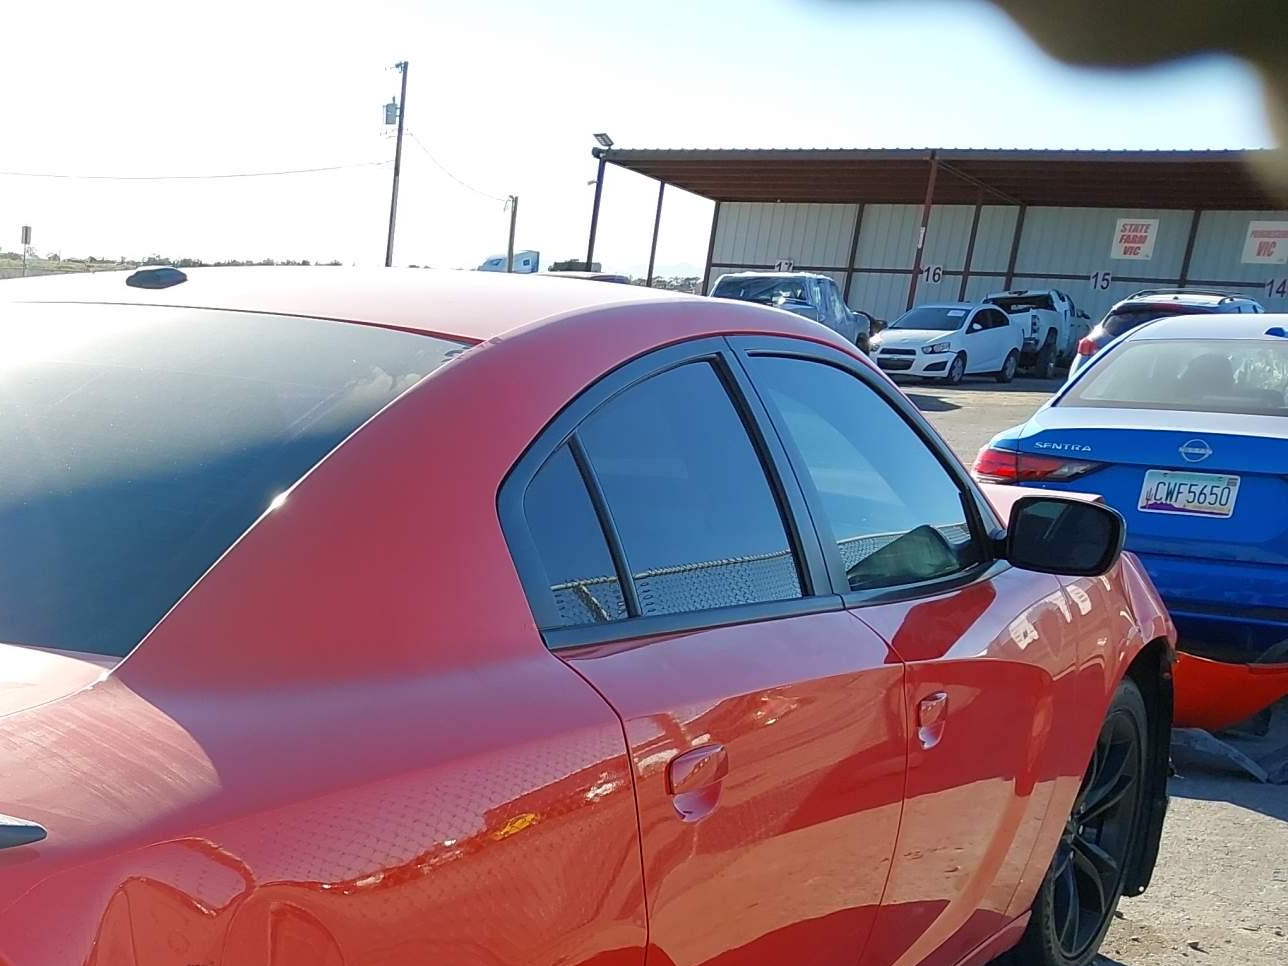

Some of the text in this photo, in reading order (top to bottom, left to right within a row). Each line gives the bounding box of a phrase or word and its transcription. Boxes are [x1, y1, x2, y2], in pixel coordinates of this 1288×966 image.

[1120, 223, 1151, 234] STATE
[1118, 234, 1148, 244] FARM
[1122, 245, 1141, 256] VIC
[923, 266, 942, 284] 16
[1091, 272, 1111, 290] 15
[1265, 279, 1288, 298] 14
[1033, 441, 1092, 452] SENTRA
[1153, 481, 1231, 507] CWF5650
